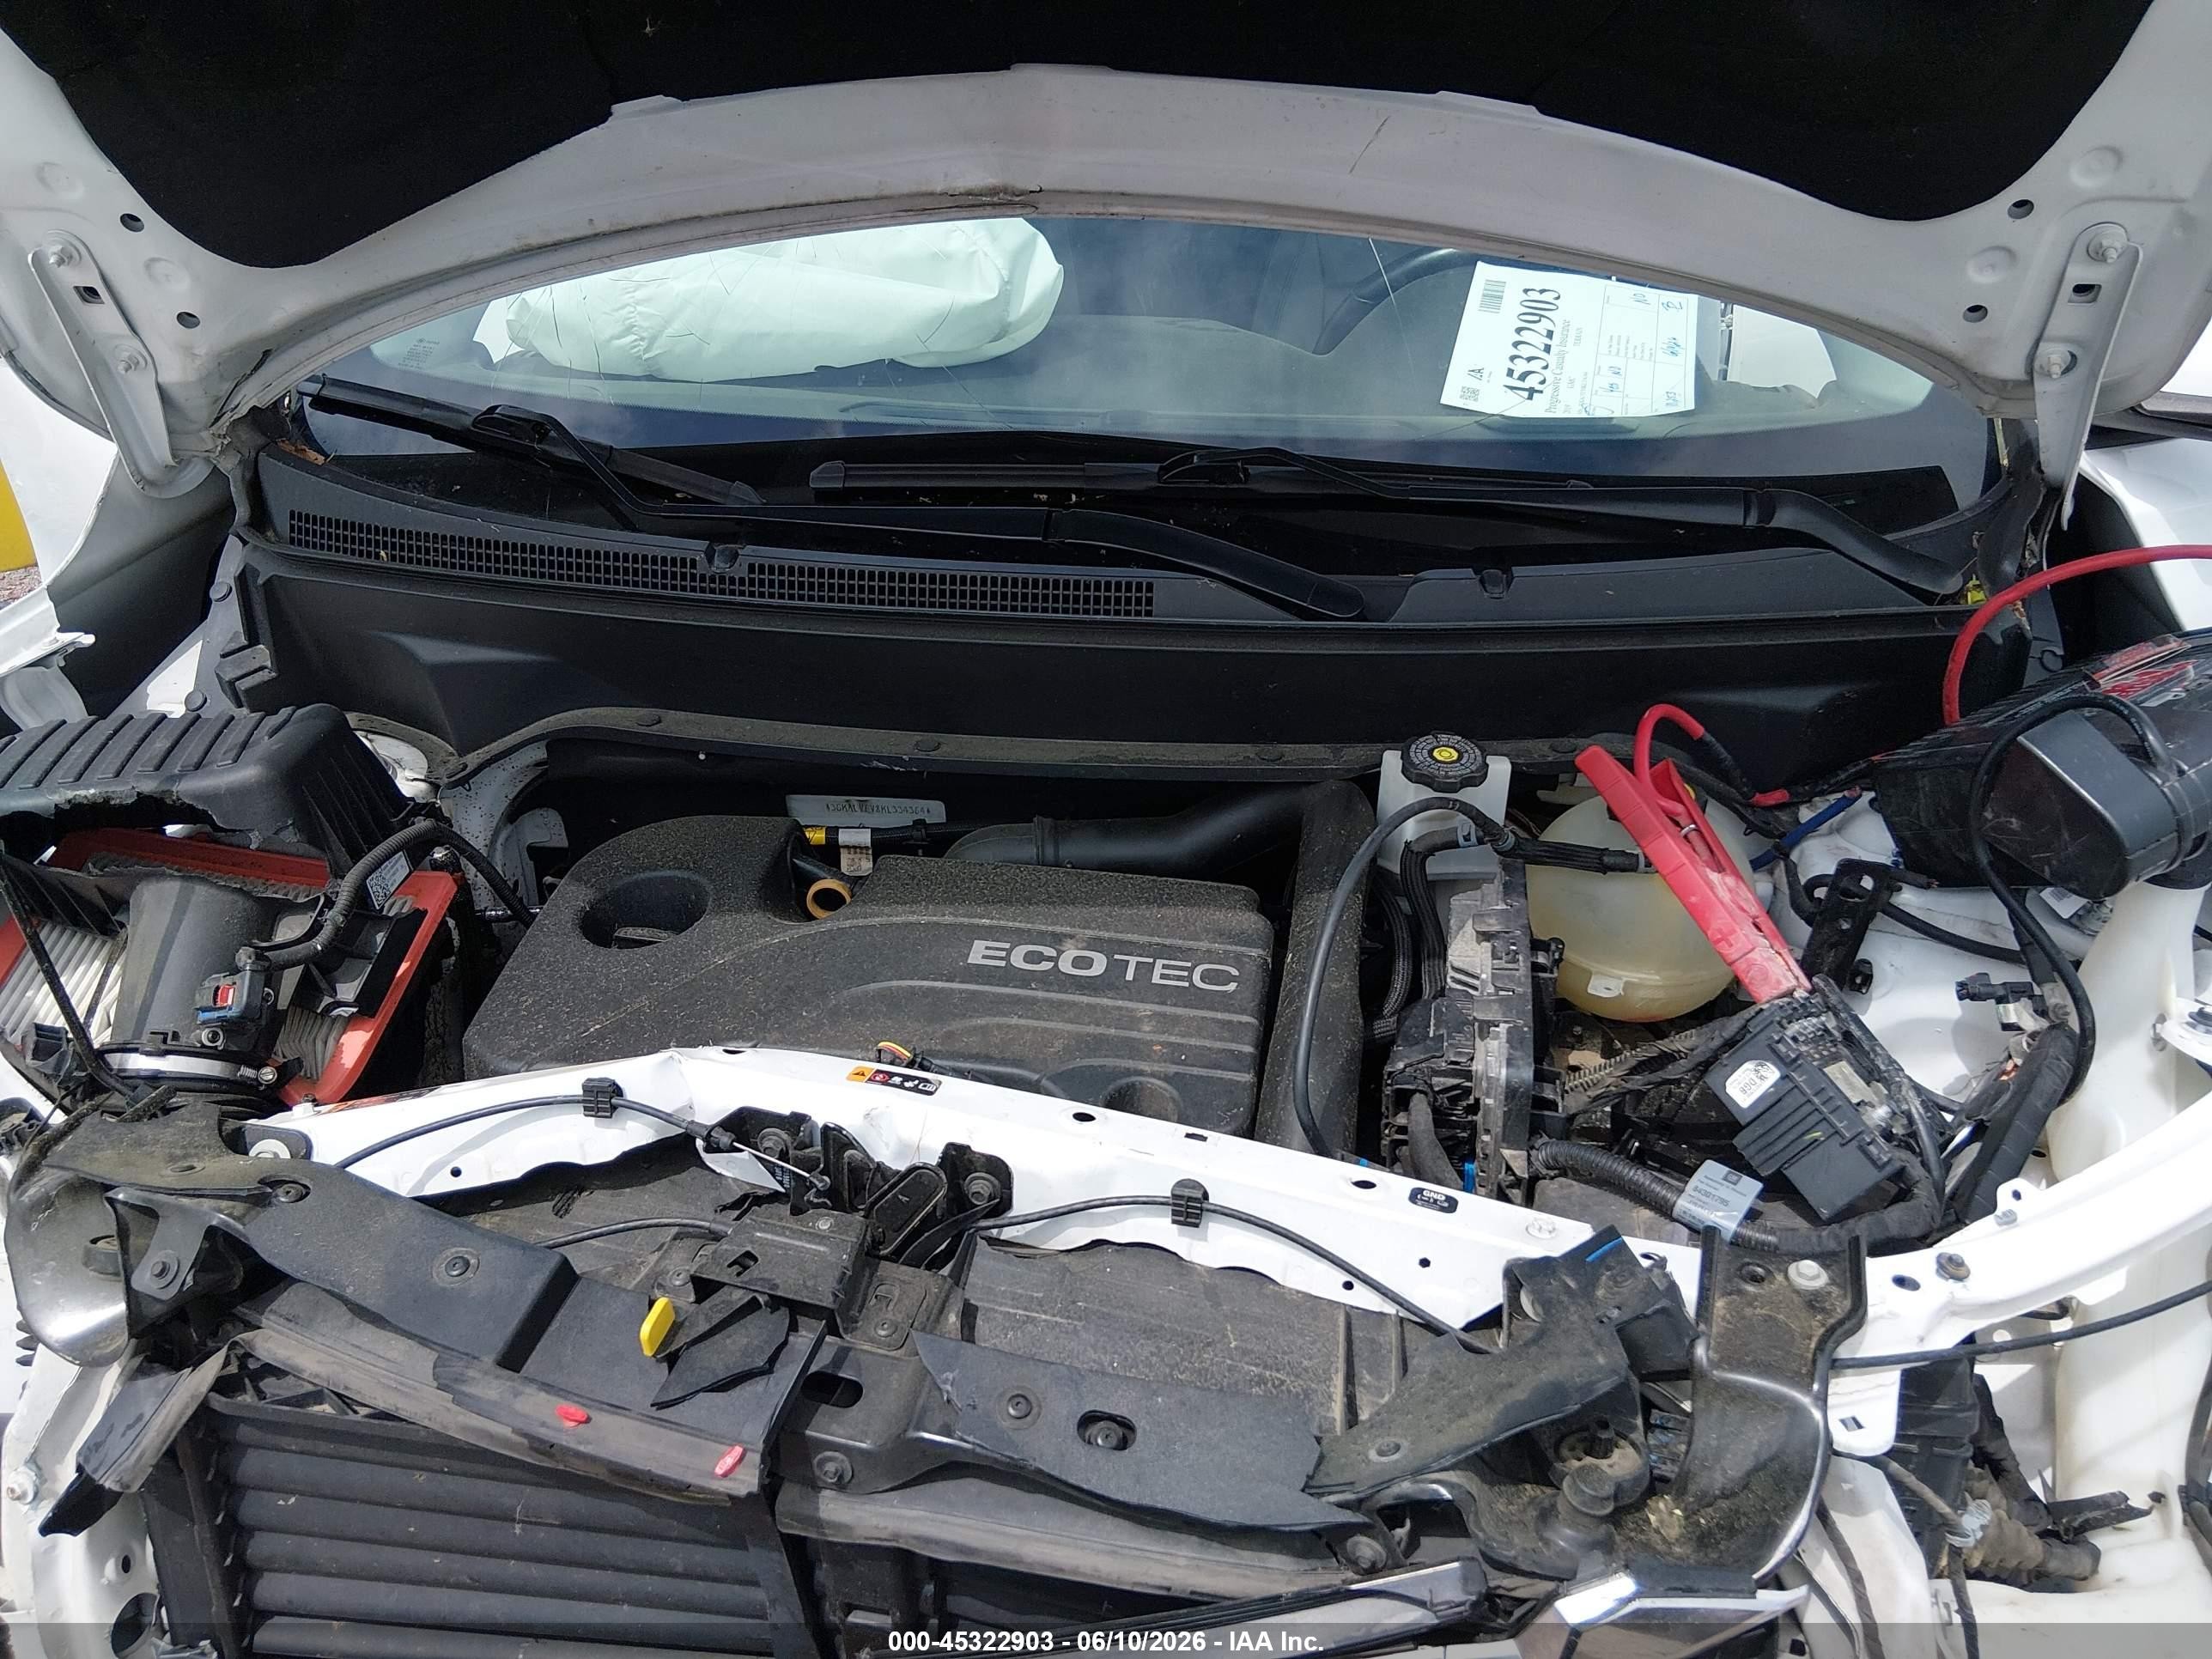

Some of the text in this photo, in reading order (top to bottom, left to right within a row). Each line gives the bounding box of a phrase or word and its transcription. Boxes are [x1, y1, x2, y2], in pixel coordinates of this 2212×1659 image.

[1503, 288, 1561, 401] 45322903
[1545, 319, 1571, 414] Progressive Casualty Insurance
[967, 939, 1240, 994] ECOTEC
[1423, 1190, 1446, 1200] GND
